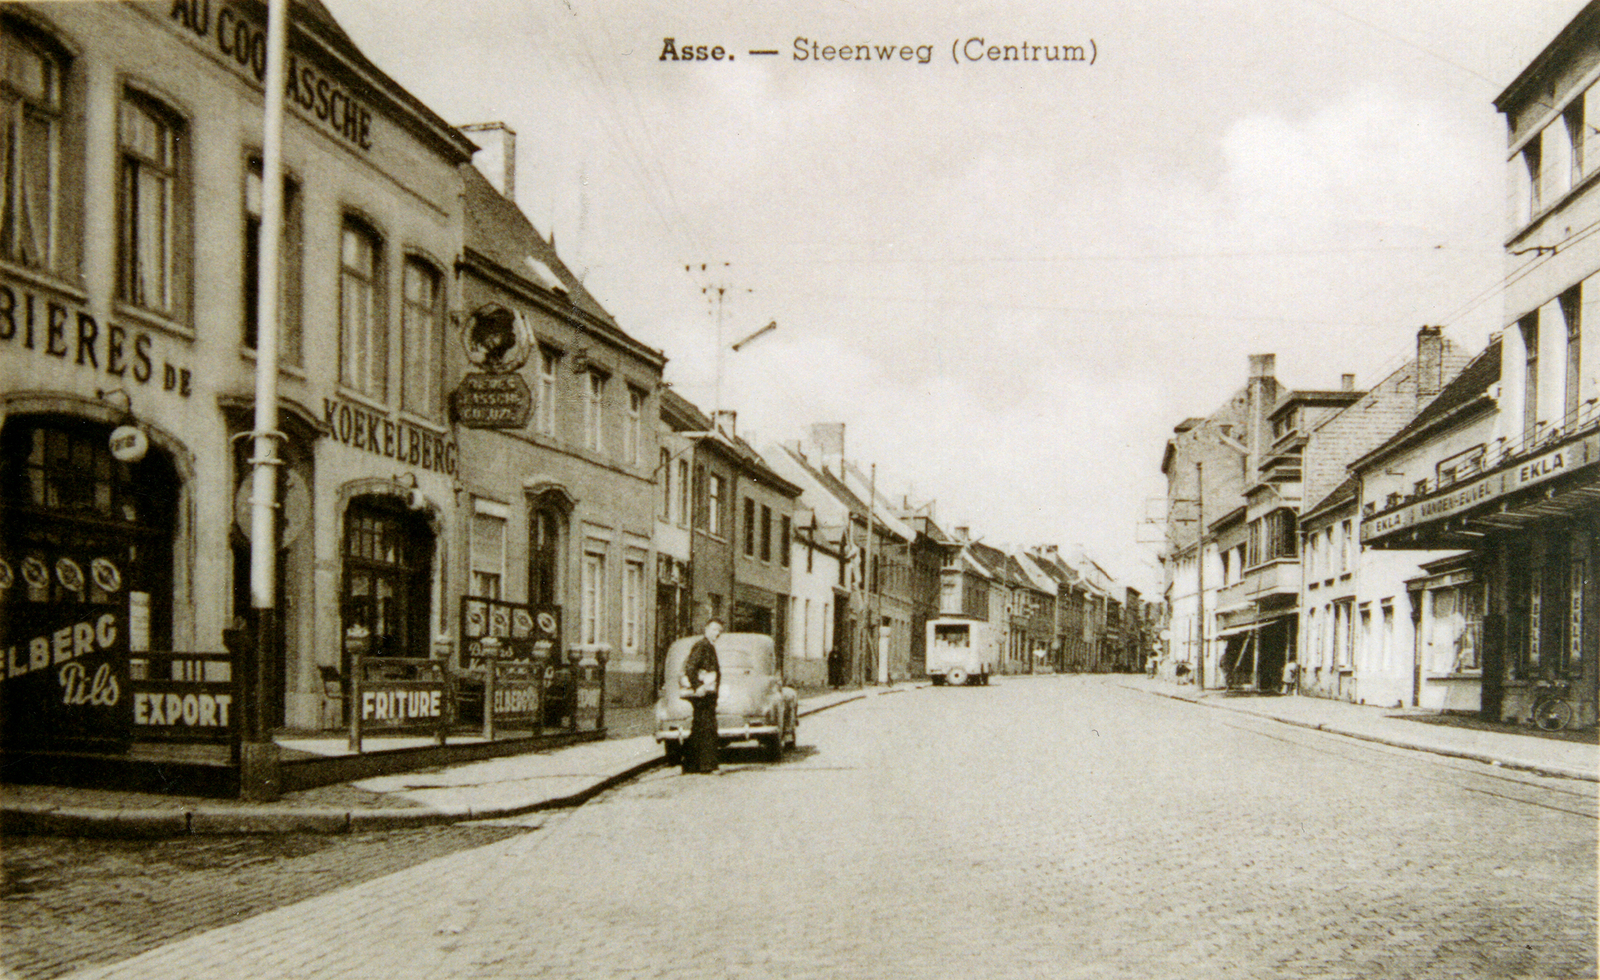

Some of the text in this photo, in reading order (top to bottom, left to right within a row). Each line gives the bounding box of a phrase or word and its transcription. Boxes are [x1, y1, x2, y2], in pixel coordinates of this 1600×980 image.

[171, 0, 208, 36] AU
[0, 284, 192, 397] BIERES DE
[322, 397, 456, 475] KOEKELBERG
[1519, 453, 1564, 483] EKLA
[1375, 513, 1401, 533] EKLA
[1573, 597, 1581, 651] EKLA
[59, 661, 120, 706] Pils
[134, 693, 232, 727] EXPORT
[362, 689, 442, 720] FRITURE
